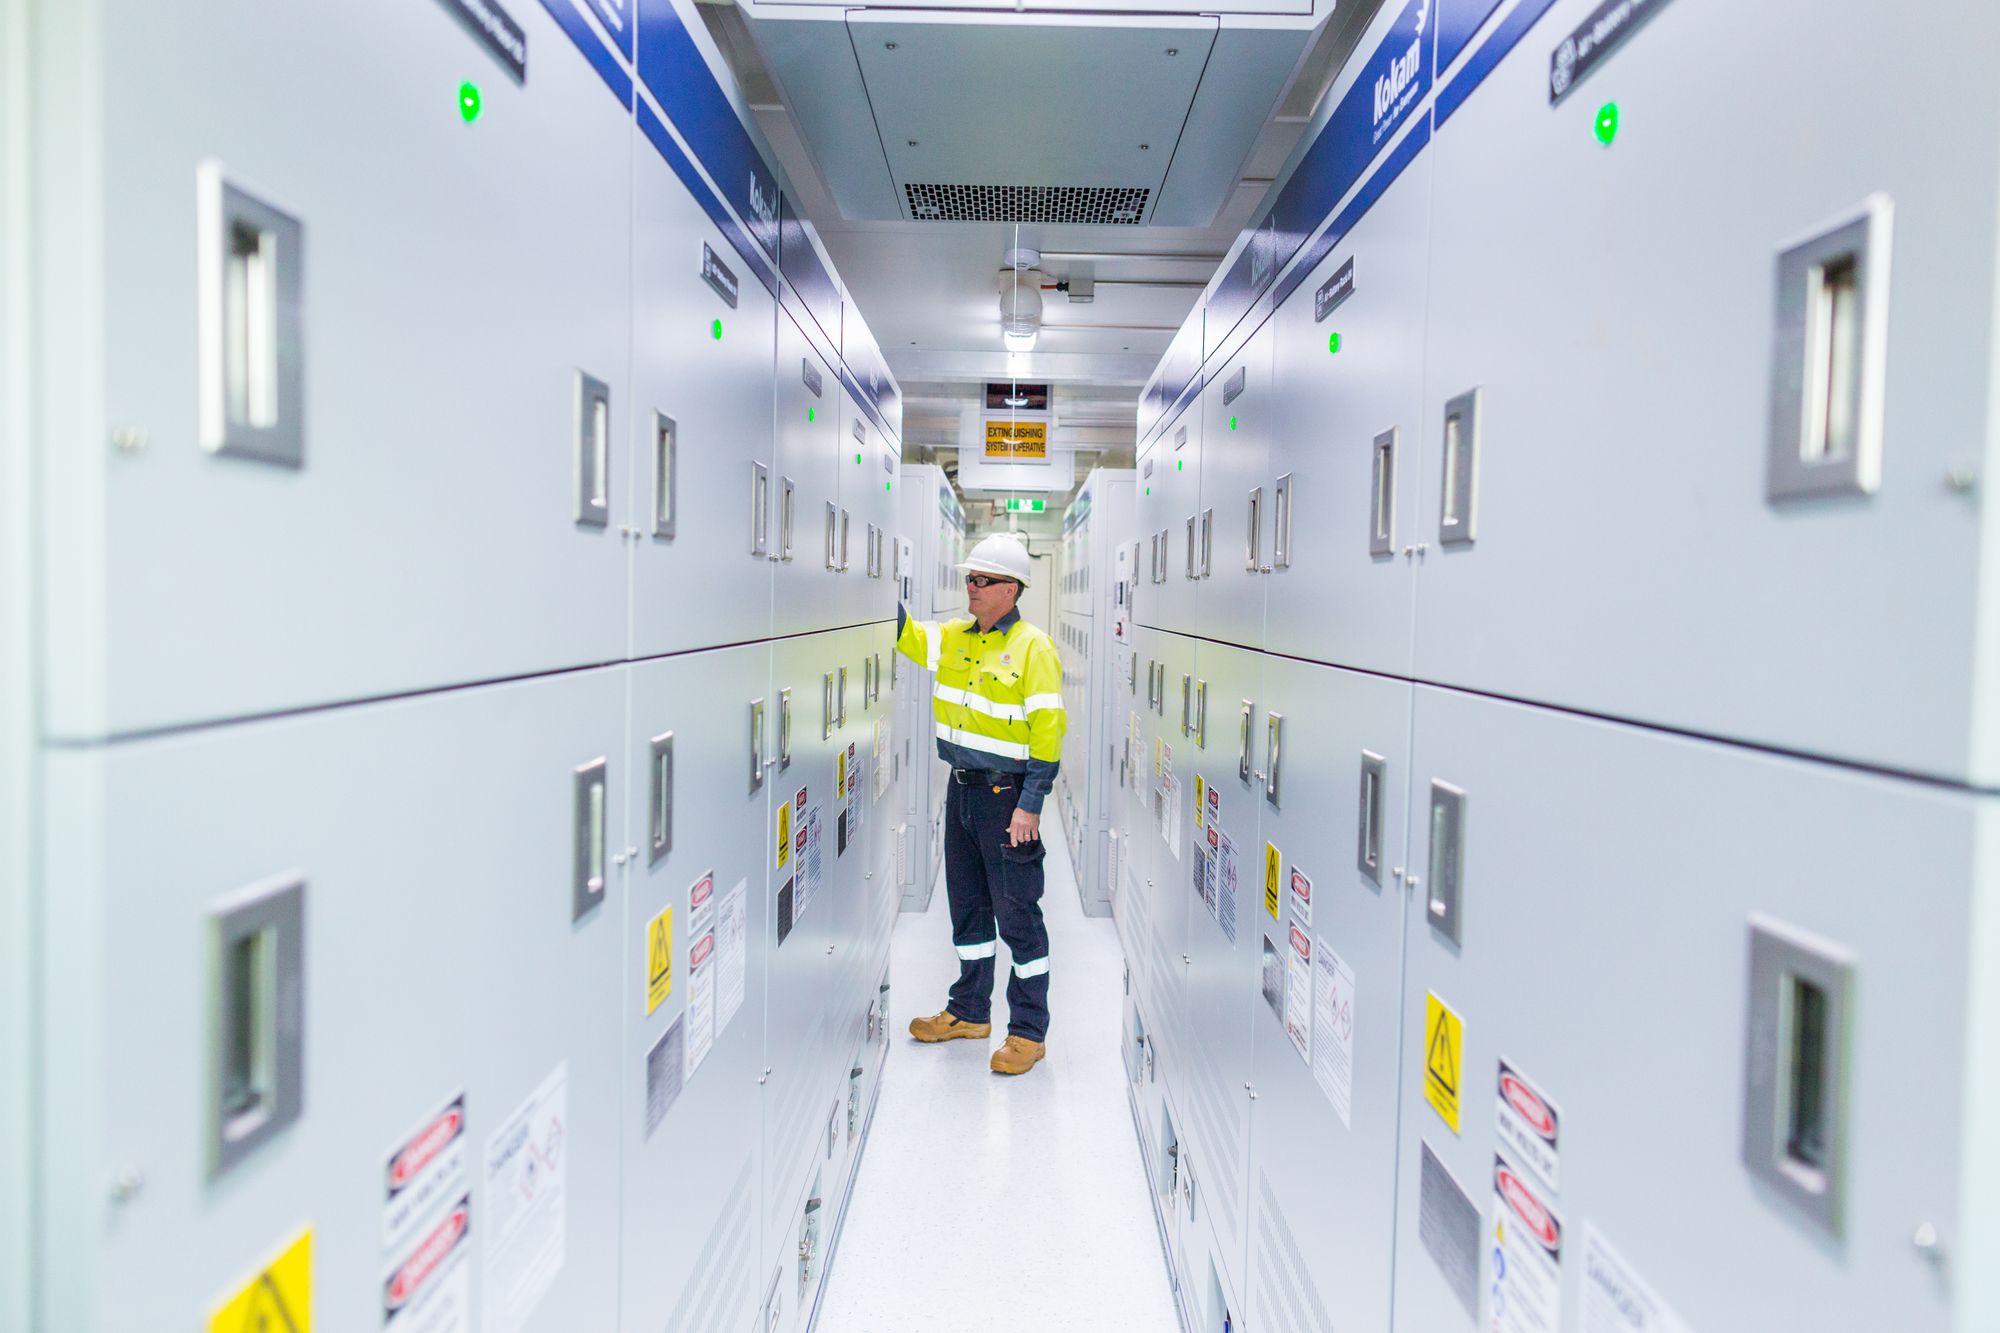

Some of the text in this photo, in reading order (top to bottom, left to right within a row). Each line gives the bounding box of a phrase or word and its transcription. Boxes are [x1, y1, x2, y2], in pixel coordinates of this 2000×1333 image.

[1373, 37, 1420, 127] Kokam
[988, 428, 1043, 438] EXTINGUISHING
[985, 441, 1008, 452] SYSTEM
